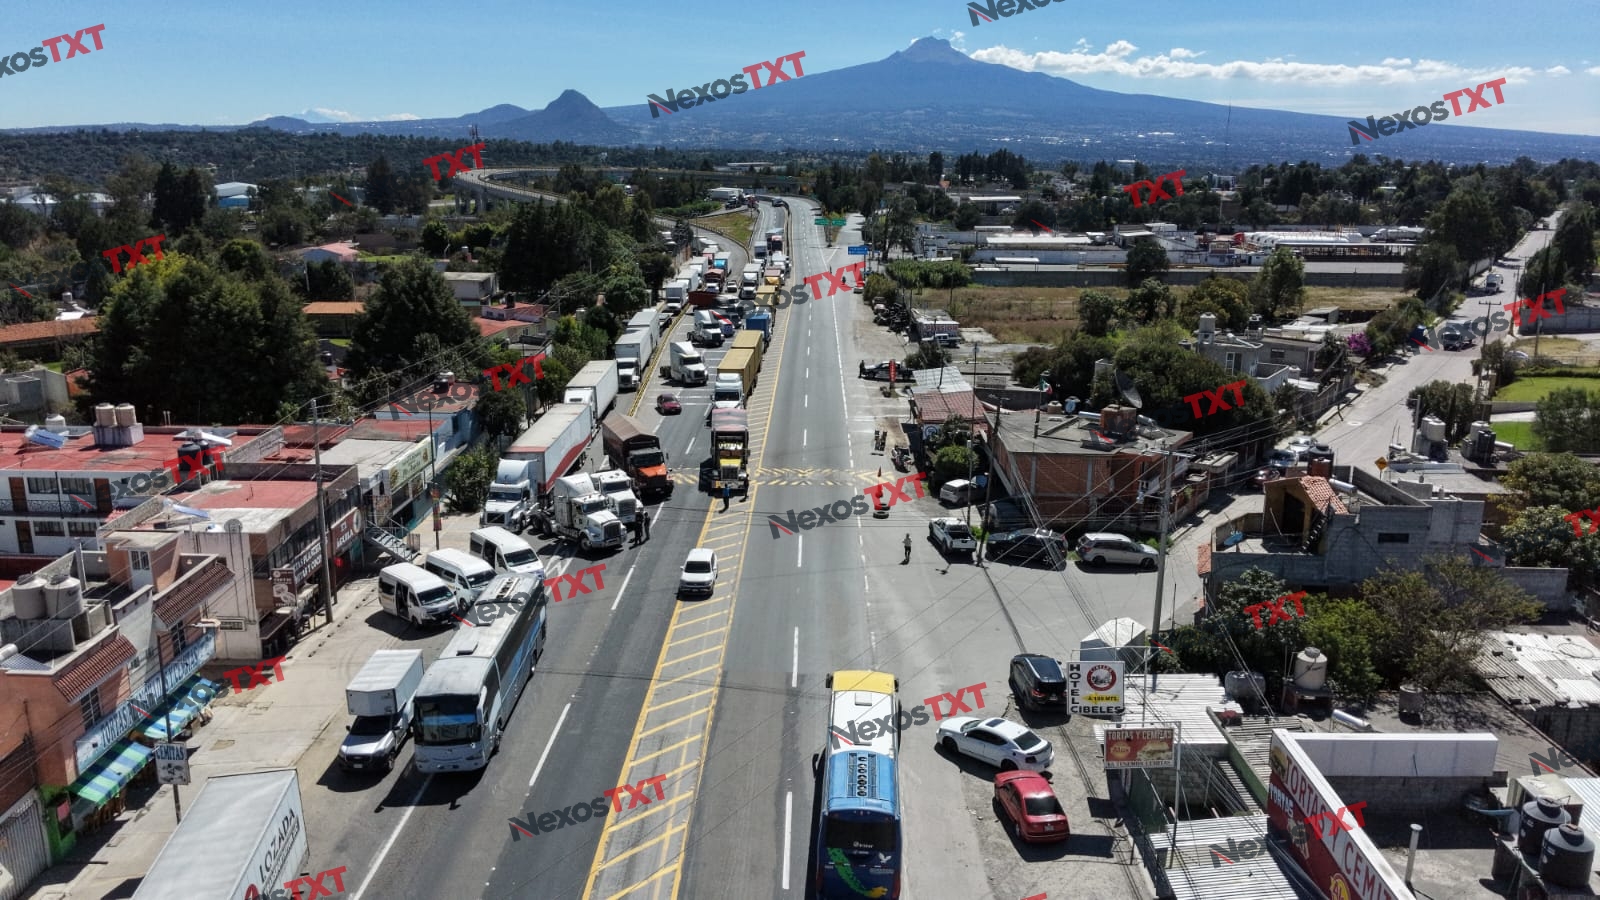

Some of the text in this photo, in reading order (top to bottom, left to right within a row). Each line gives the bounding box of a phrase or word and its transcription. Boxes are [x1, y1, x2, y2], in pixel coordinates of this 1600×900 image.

[1069, 663, 1081, 704] HOTEL
[156, 745, 184, 760] CEMITAS
[1108, 731, 1134, 740] TORTAS
[1286, 755, 1327, 833] TORTAS
[259, 808, 295, 883] LOZADA
